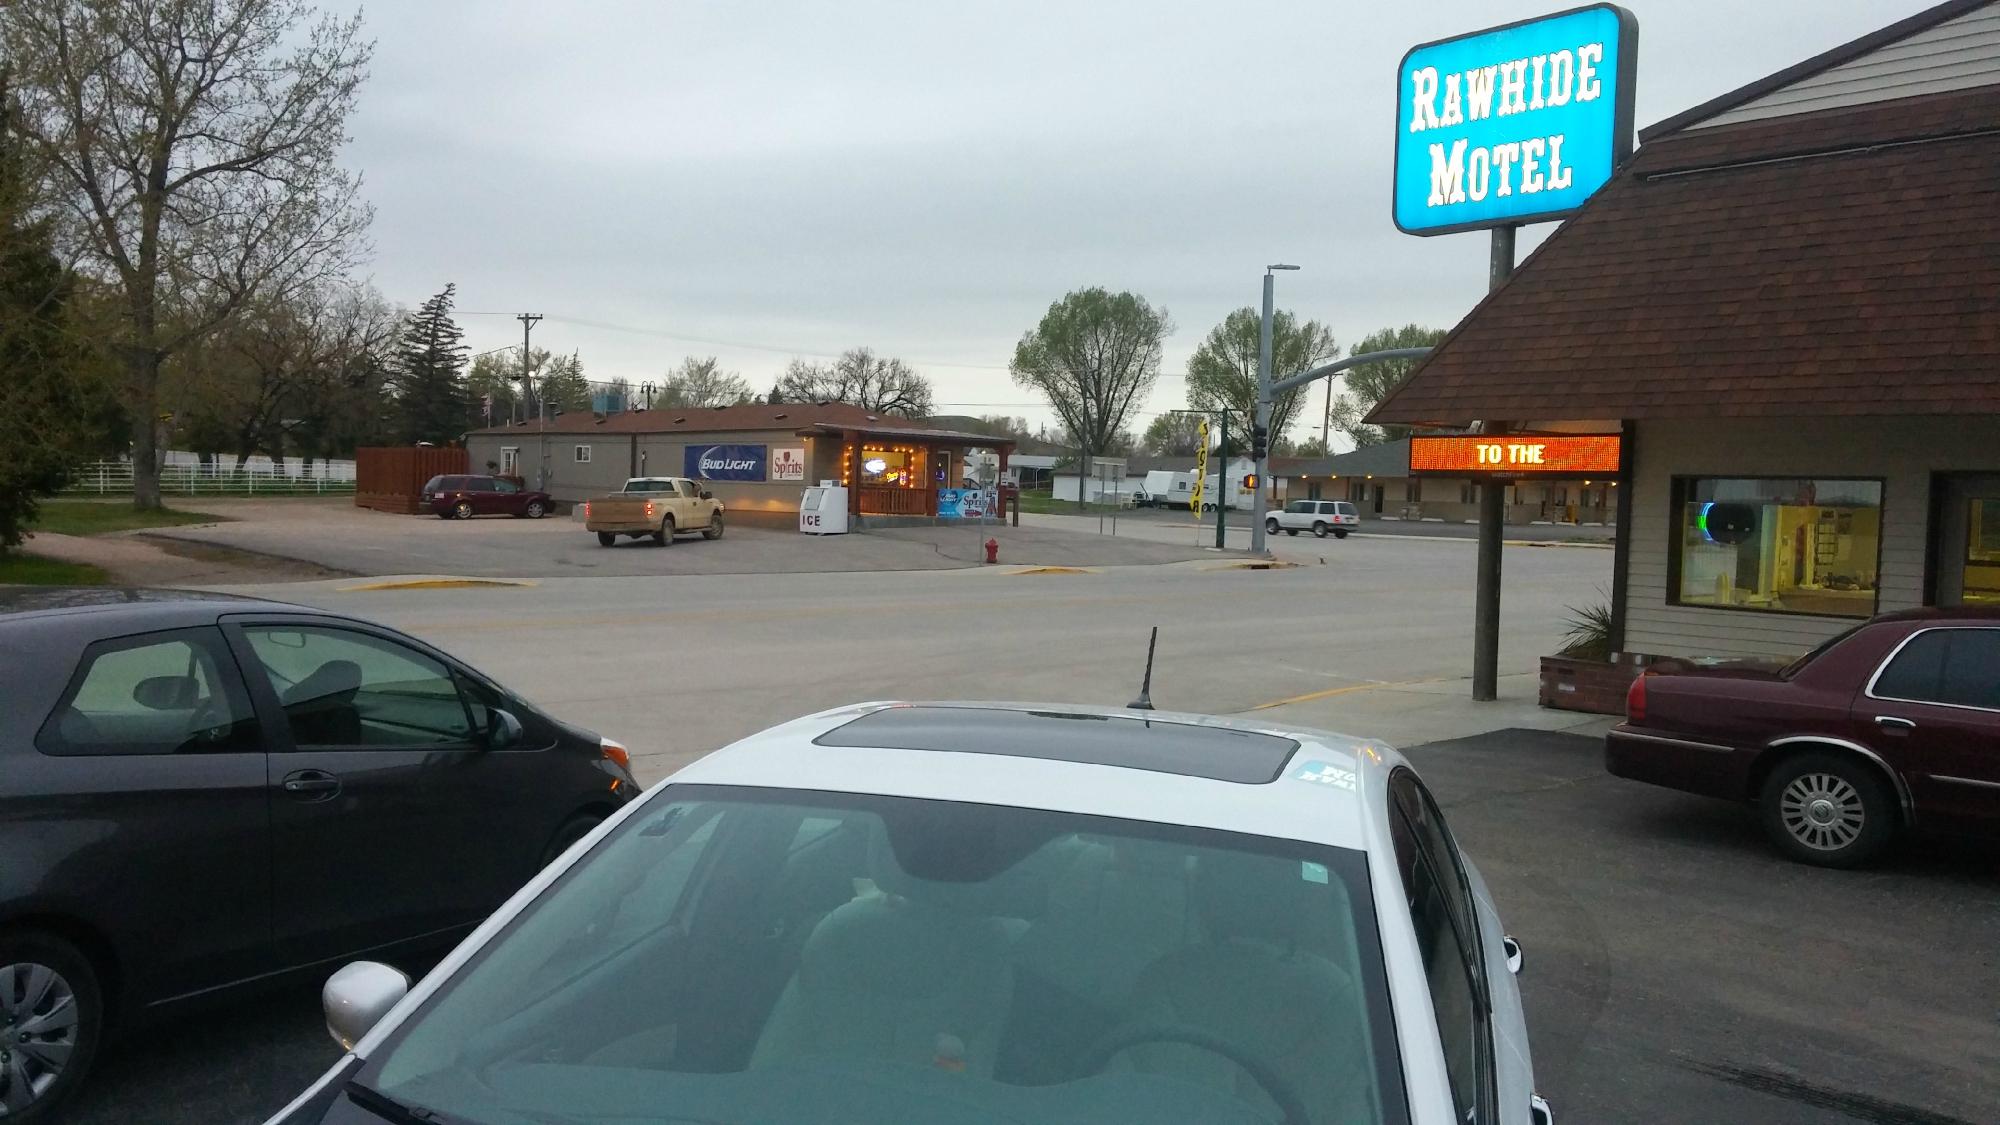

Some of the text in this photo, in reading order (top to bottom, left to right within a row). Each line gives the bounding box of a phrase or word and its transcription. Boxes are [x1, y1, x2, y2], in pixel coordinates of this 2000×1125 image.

[1409, 42, 1604, 133] RAWHIDE
[1427, 133, 1573, 208] MOTEL
[702, 458, 756, 470] BUD LIGHT
[1476, 444, 1546, 464] TO THE
[802, 514, 821, 526] ICE
